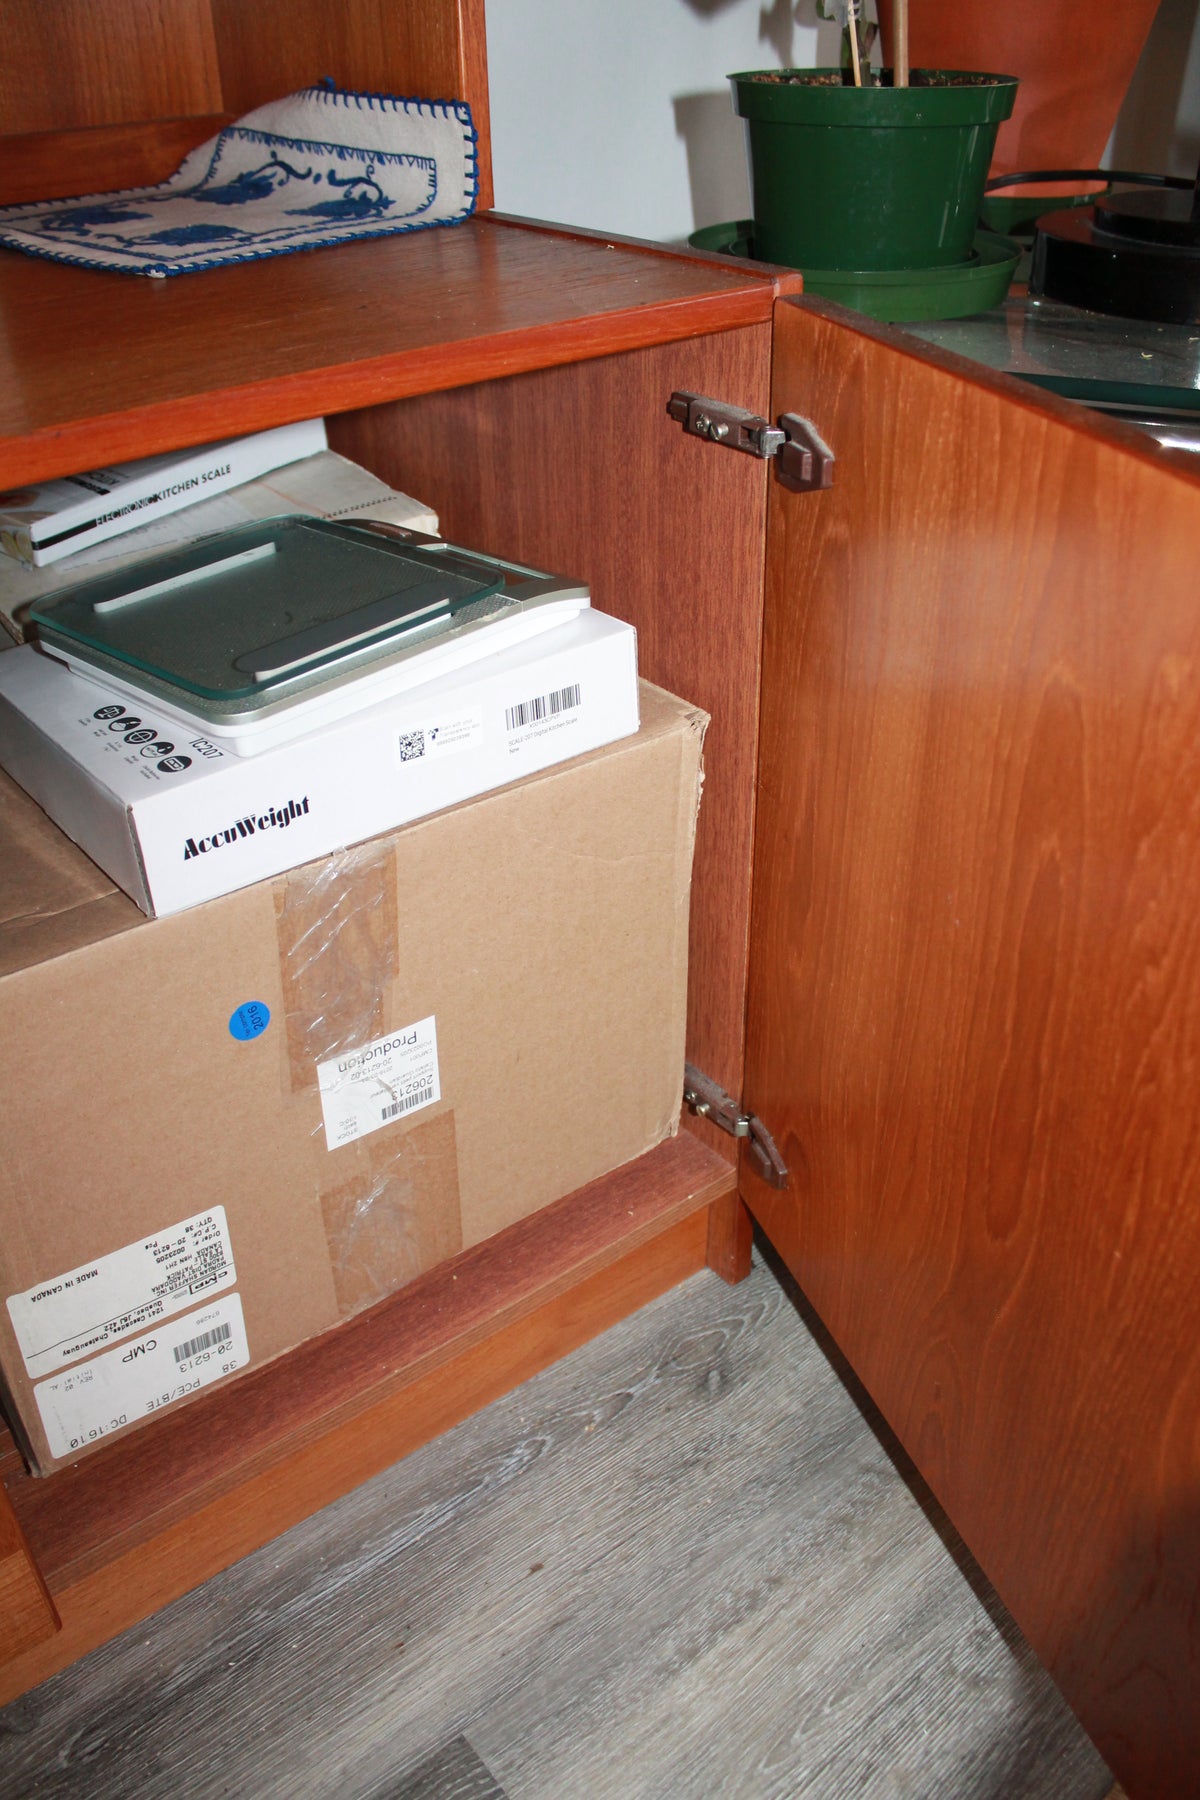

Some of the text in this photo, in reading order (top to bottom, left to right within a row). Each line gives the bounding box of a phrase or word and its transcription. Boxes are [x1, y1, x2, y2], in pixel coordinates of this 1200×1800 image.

[156, 477, 198, 501] KITCHEN
[202, 464, 231, 482] SCALE
[189, 737, 224, 759] IC207
[184, 795, 309, 861] AccuWeight
[247, 1005, 264, 1031] 2016
[337, 1030, 417, 1076] Production
[390, 1073, 433, 1101] 206213
[184, 1224, 194, 1233] 38
[200, 1229, 220, 1243] Order
[195, 1240, 222, 1256] CANADA
[198, 1259, 226, 1277] MORGAN
[29, 1268, 98, 1303] MADE IN CANADA
[168, 1273, 198, 1291] SHAFFER
[147, 1305, 164, 1318] 1241
[61, 1330, 108, 1358] Chateauguay
[120, 1337, 157, 1364] CMP
[178, 1339, 233, 1374] 20-6213
[221, 1358, 237, 1373] 38
[145, 1376, 200, 1412] PCE/BTE
